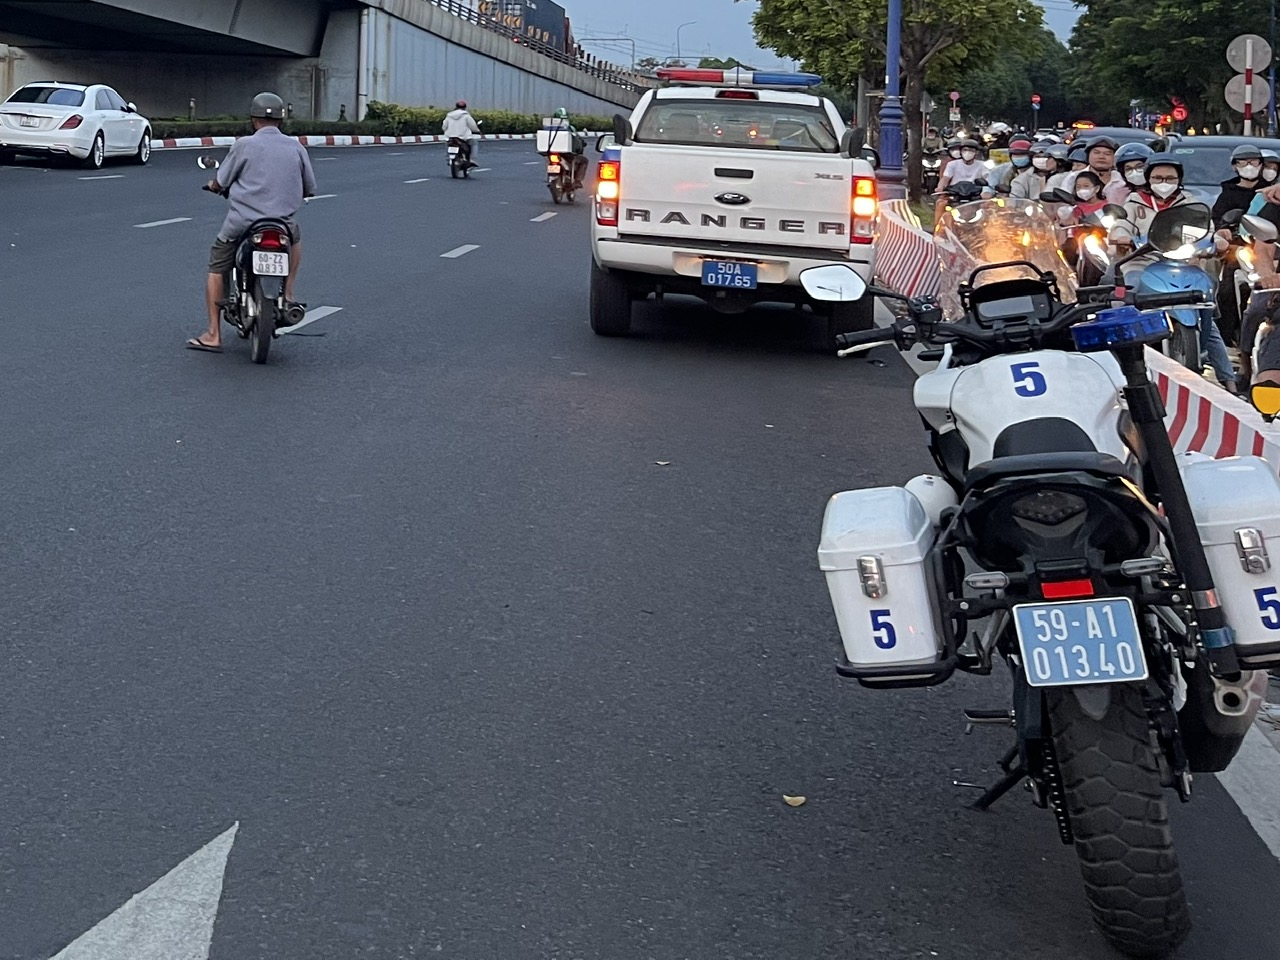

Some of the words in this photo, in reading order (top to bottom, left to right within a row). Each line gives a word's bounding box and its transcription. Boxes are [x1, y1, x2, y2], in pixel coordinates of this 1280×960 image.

[625, 208, 846, 236] RANGER
[707, 273, 751, 287] 017.65
[718, 262, 741, 274] 50A
[1010, 362, 1047, 397] 5
[1032, 605, 1118, 642] 59-A1
[1253, 586, 1280, 630] 5
[869, 609, 897, 650] 5
[1032, 641, 1136, 680] 013.40
